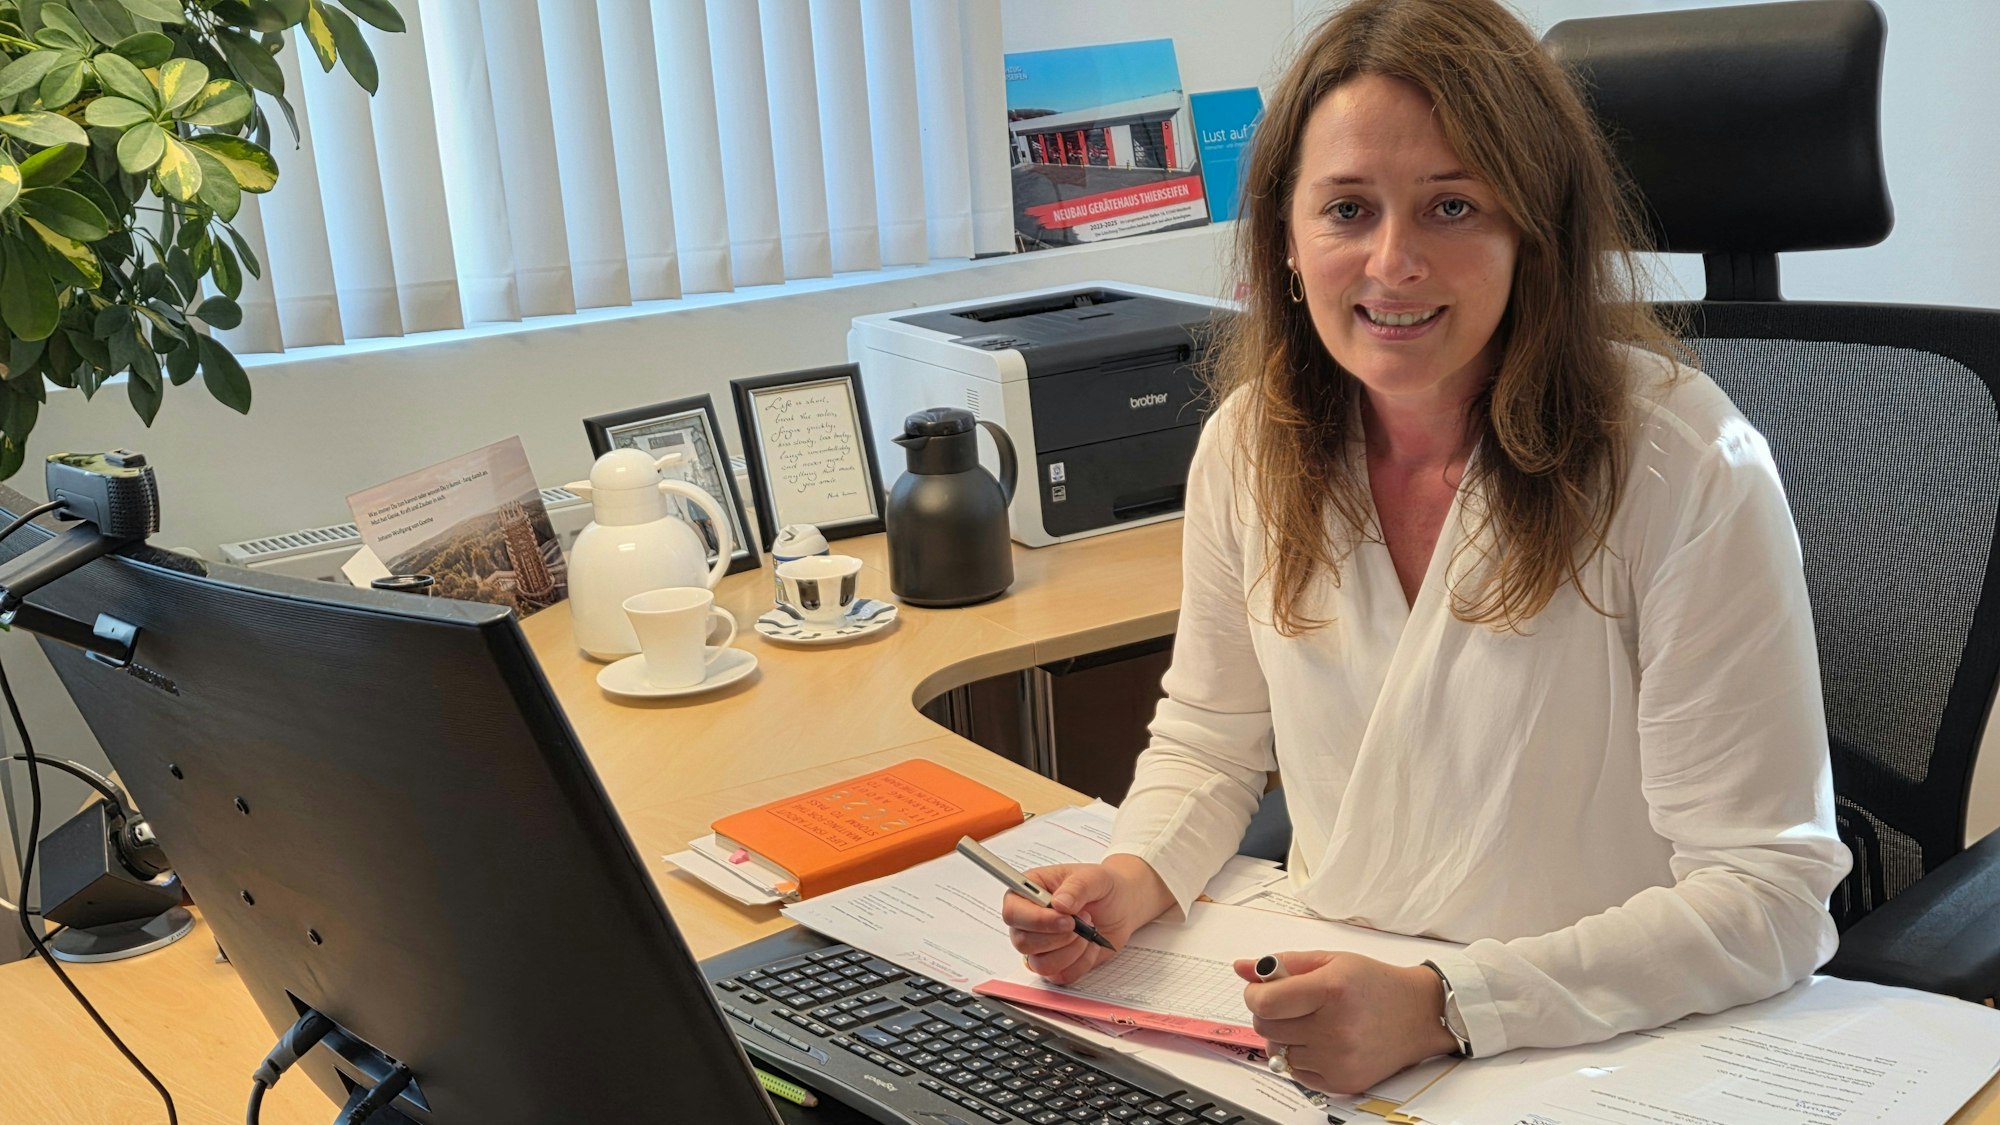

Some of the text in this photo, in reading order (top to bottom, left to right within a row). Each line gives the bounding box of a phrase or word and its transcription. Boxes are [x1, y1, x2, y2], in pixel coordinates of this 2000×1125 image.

[1202, 124, 1247, 142] Lust auf
[1053, 184, 1190, 222] NEUBAU GERÄTEHAUS THIERSEIFEN
[1090, 220, 1118, 230] 2023-2025
[765, 397, 792, 413] Life
[1130, 393, 1167, 408] brother
[392, 526, 411, 535] Wolfgang
[852, 786, 890, 803] ABOUT
[807, 800, 829, 810] PASS
[888, 791, 938, 816] LEARNING
[923, 797, 953, 811] DANCE
[776, 811, 806, 823] ABOUT
[823, 821, 861, 841] WAITING
[845, 819, 878, 835] STORM
[826, 835, 847, 846] LIFE
